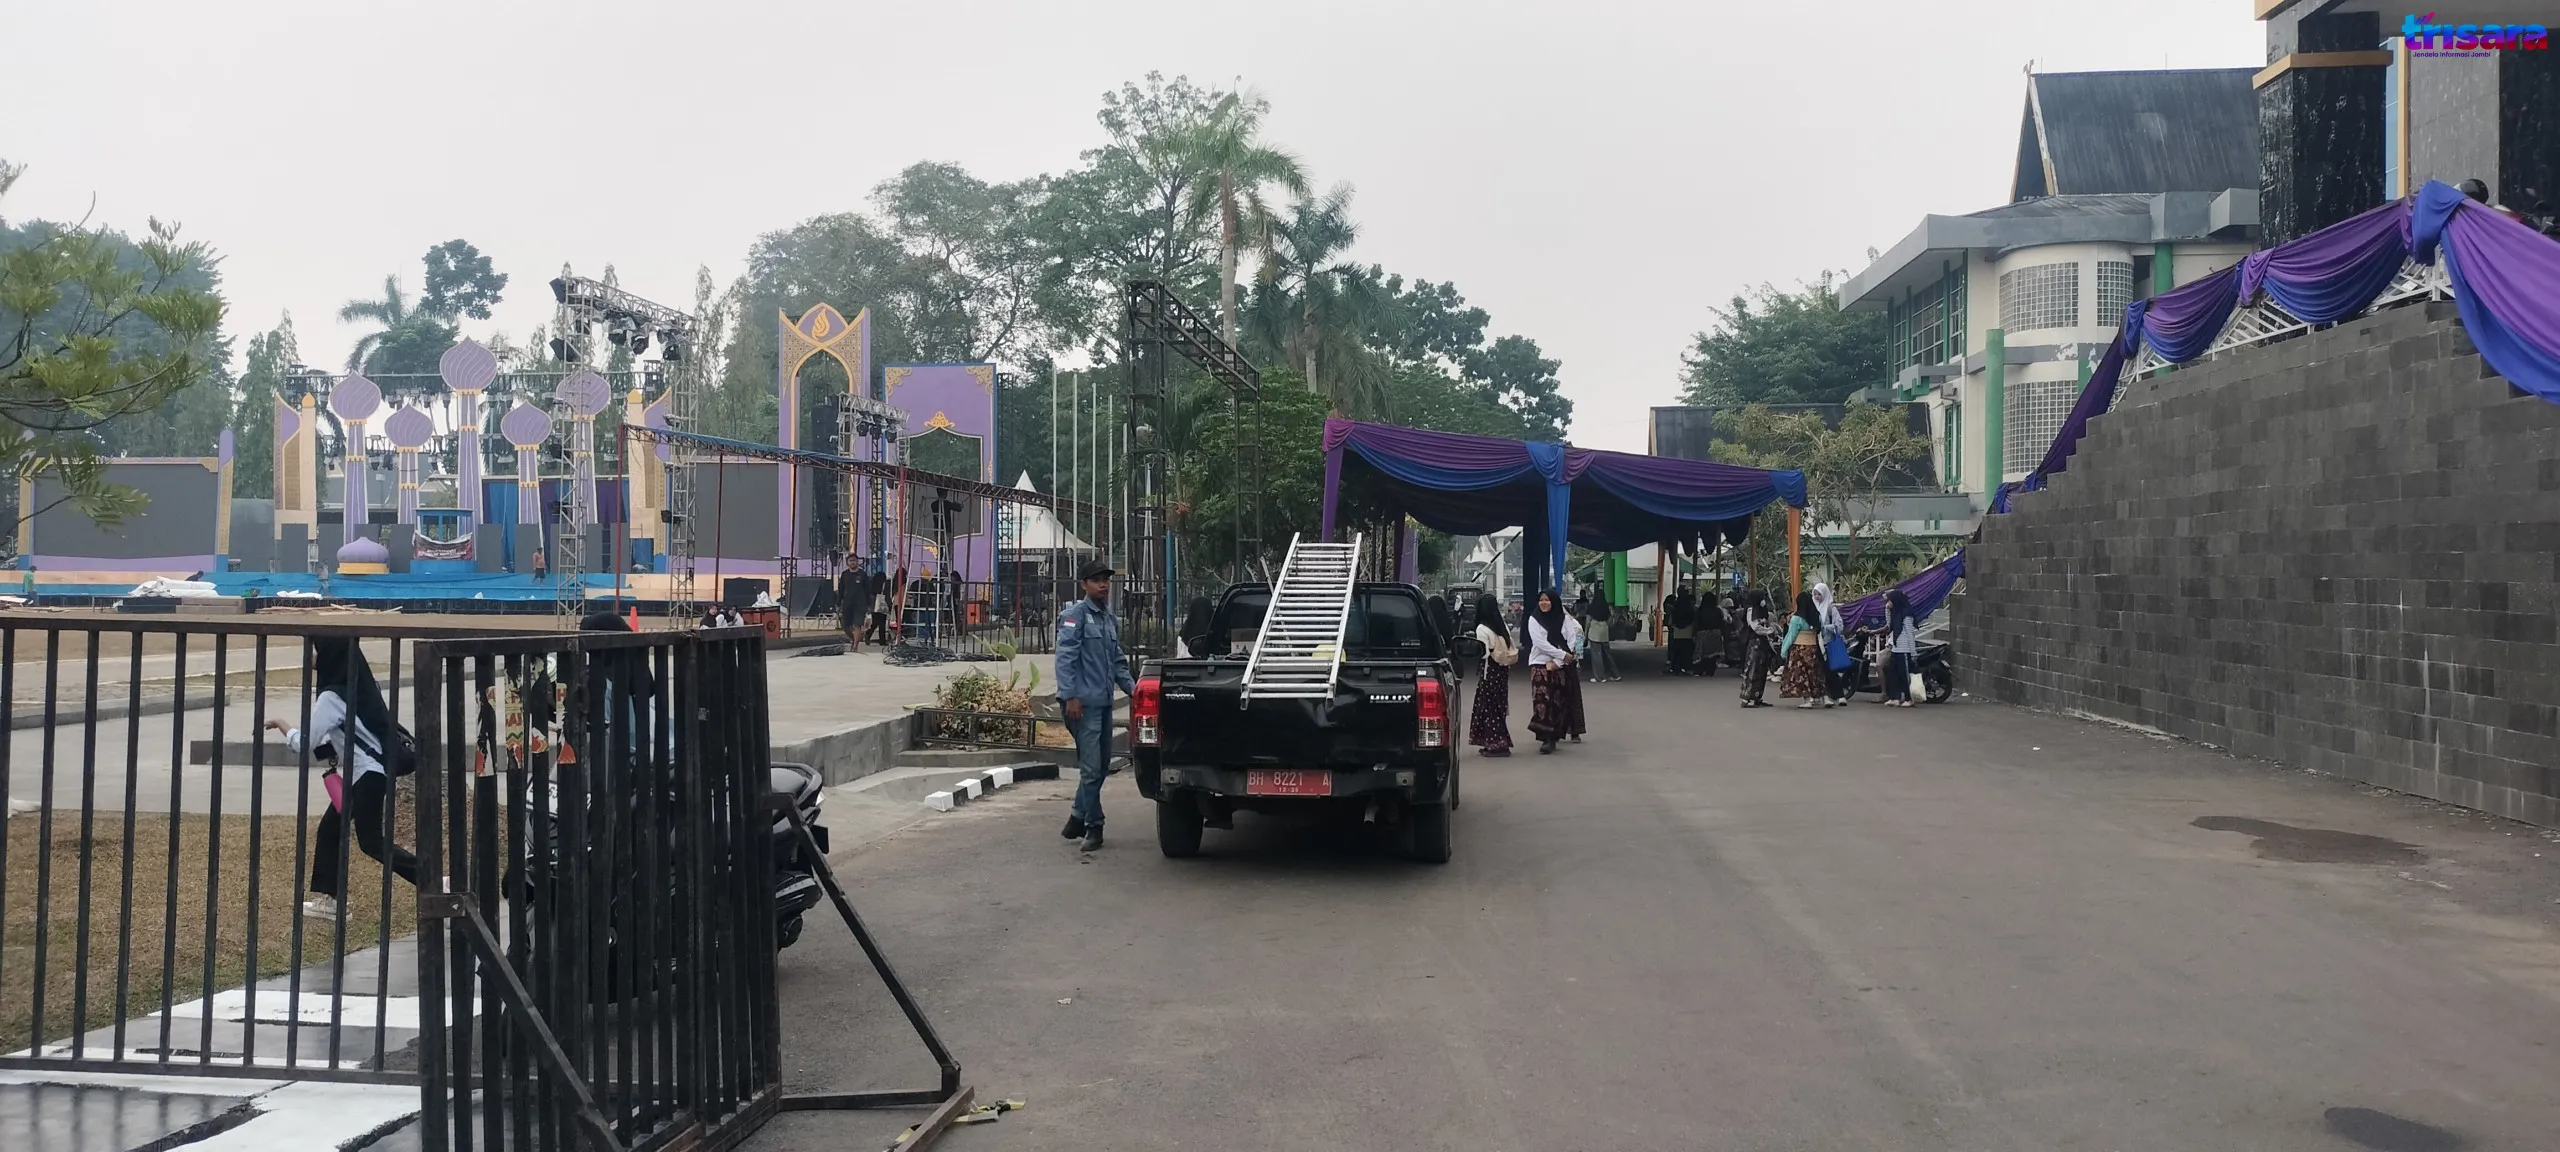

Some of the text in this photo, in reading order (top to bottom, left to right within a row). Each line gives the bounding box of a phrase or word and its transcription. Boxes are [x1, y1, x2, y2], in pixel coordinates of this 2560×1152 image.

[1165, 693, 1196, 701] TOYOTA
[1370, 694, 1412, 703] HILUX
[1249, 771, 1329, 786] BH 8221 A
